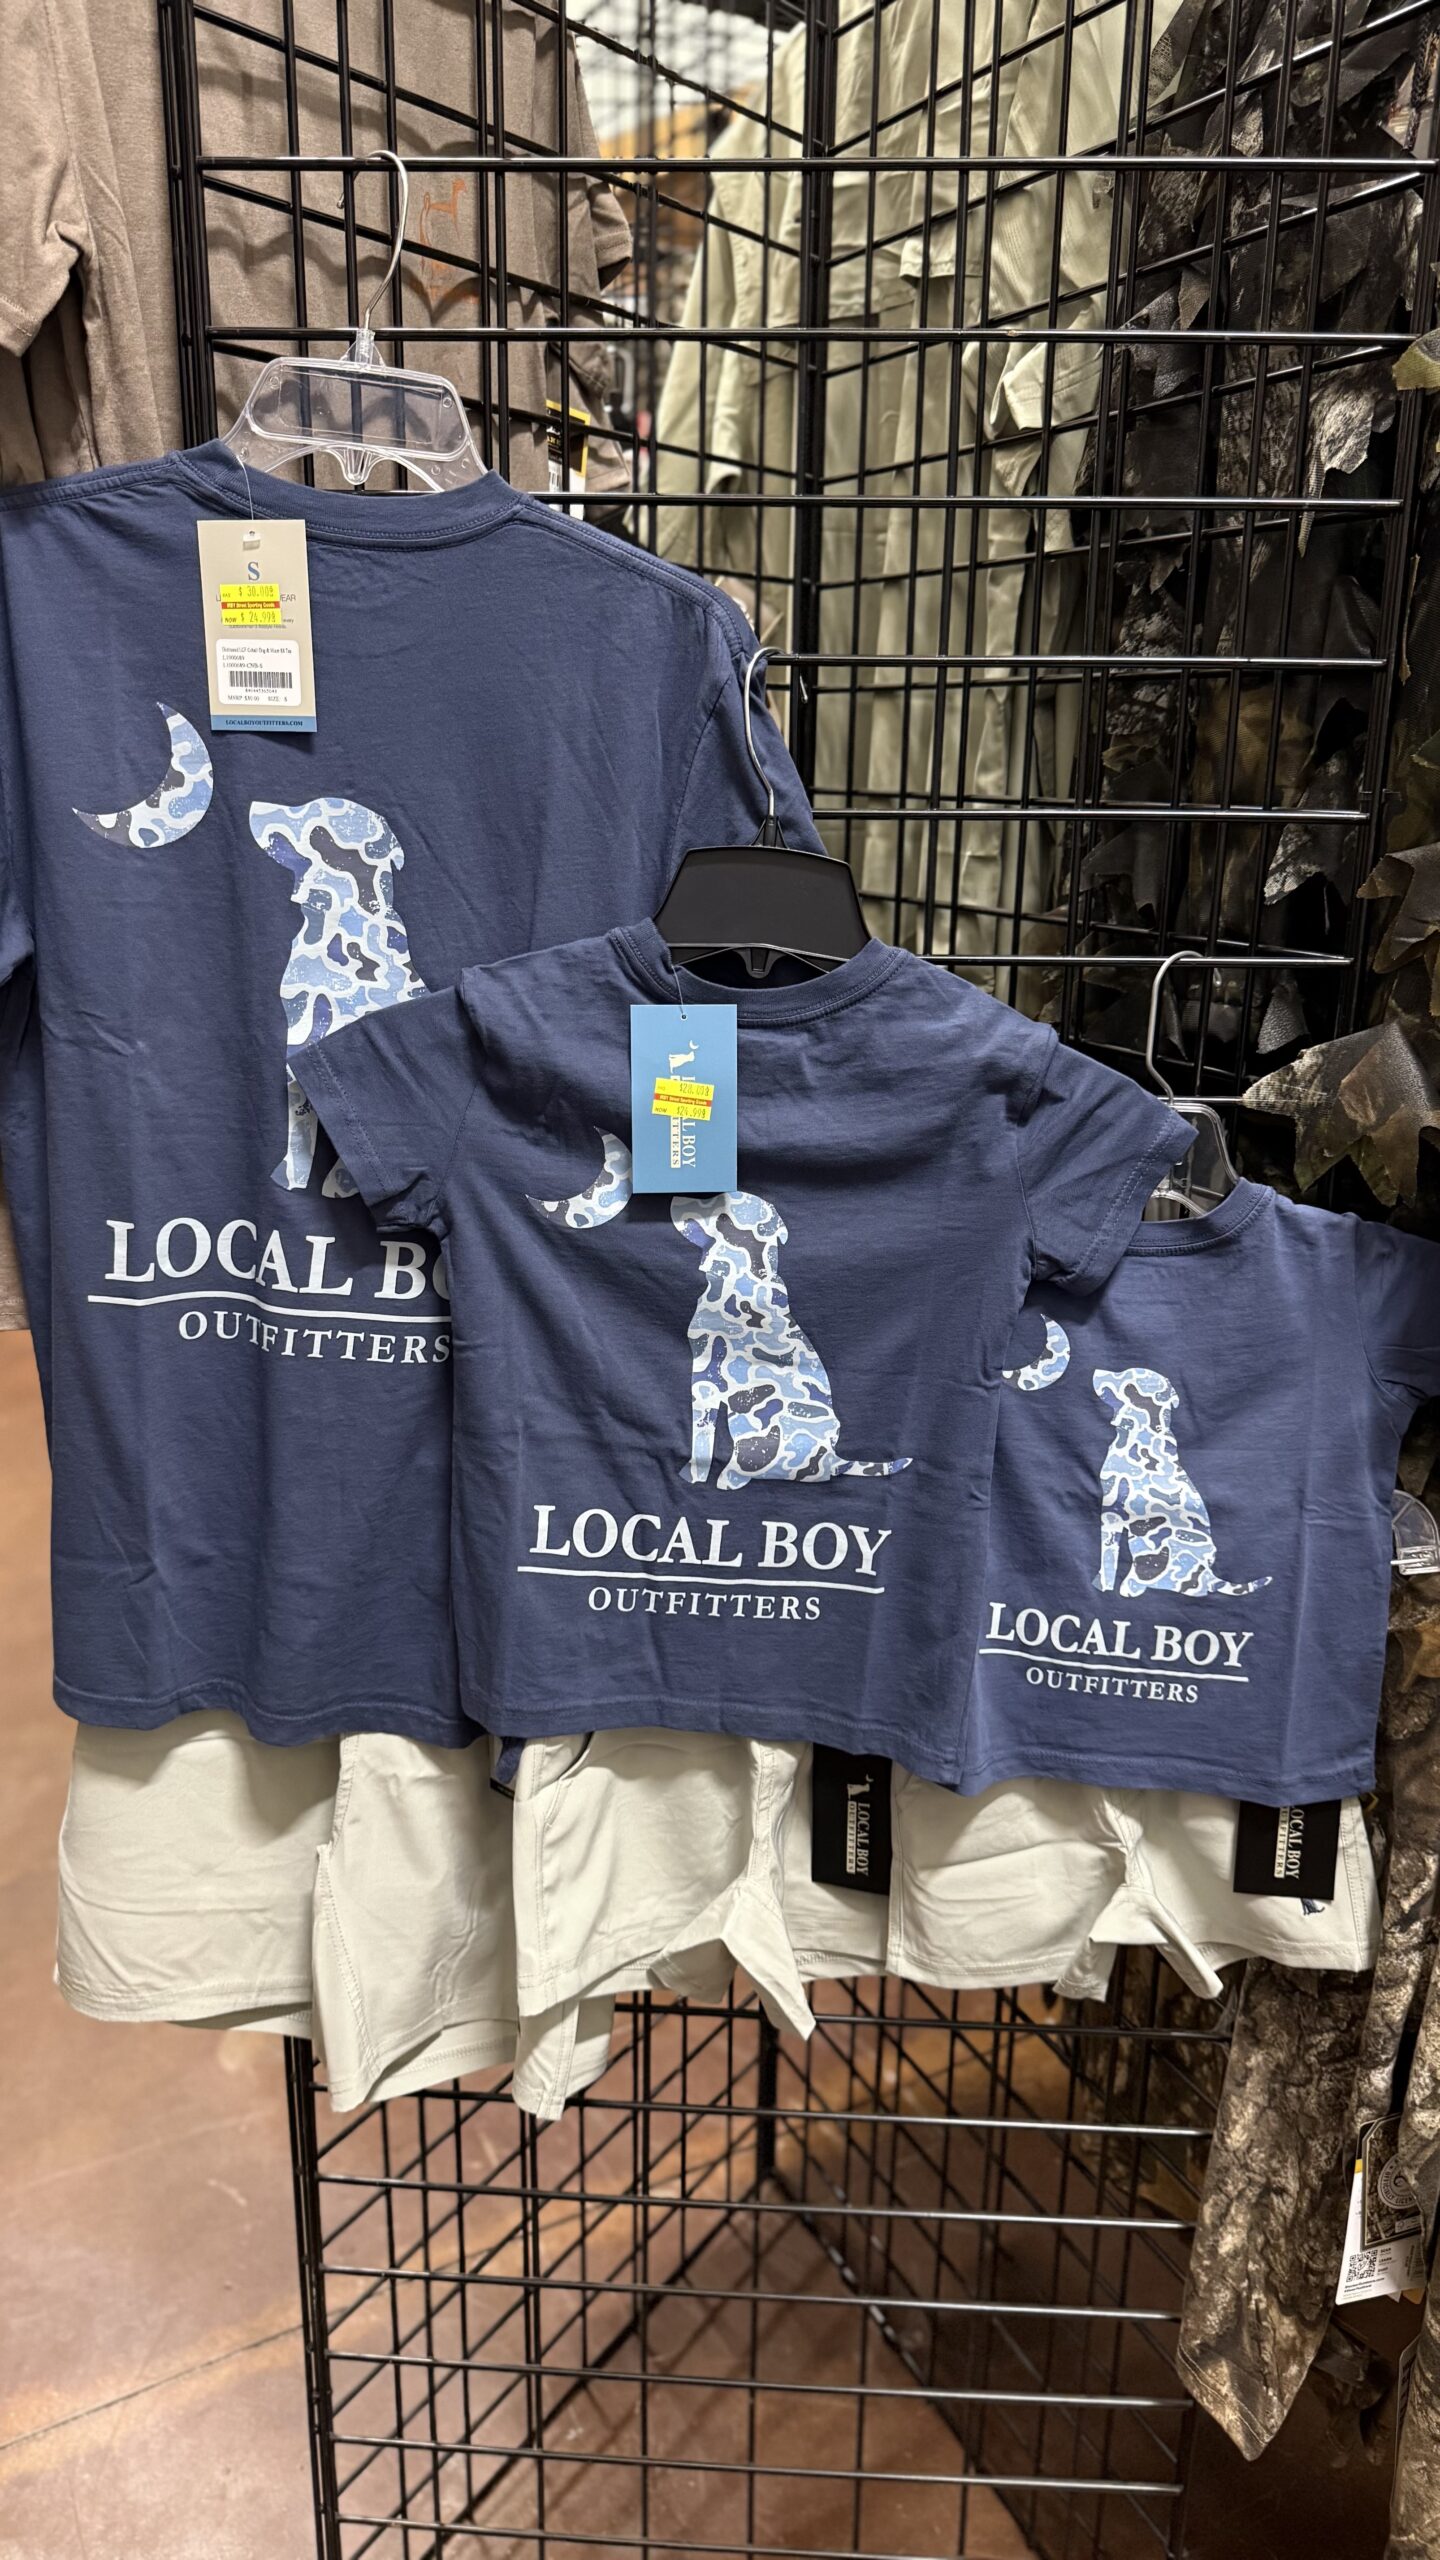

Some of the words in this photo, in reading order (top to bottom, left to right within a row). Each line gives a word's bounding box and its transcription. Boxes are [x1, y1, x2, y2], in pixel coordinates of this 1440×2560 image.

[247, 561, 260, 581] S
[682, 1135, 696, 1168] BOY
[104, 1217, 354, 1296] LOCAL
[178, 1310, 451, 1365] OUTFITTERS
[529, 1504, 743, 1568] LOCAL
[757, 1520, 893, 1577] BOY
[588, 1586, 821, 1621] OUTFITTERS
[985, 1601, 1141, 1660] LOCAL
[1150, 1624, 1254, 1668] BOY
[1026, 1666, 1199, 1704] OUTFITTERS
[847, 1802, 856, 1871] OUTFITTERS
[857, 1802, 871, 1847] LOCAL
[1276, 1806, 1289, 1875] UTFITTERS
[1288, 1806, 1305, 1848] OCAL
[856, 1848, 869, 1877] BOY
[1285, 1849, 1301, 1880] BOY
